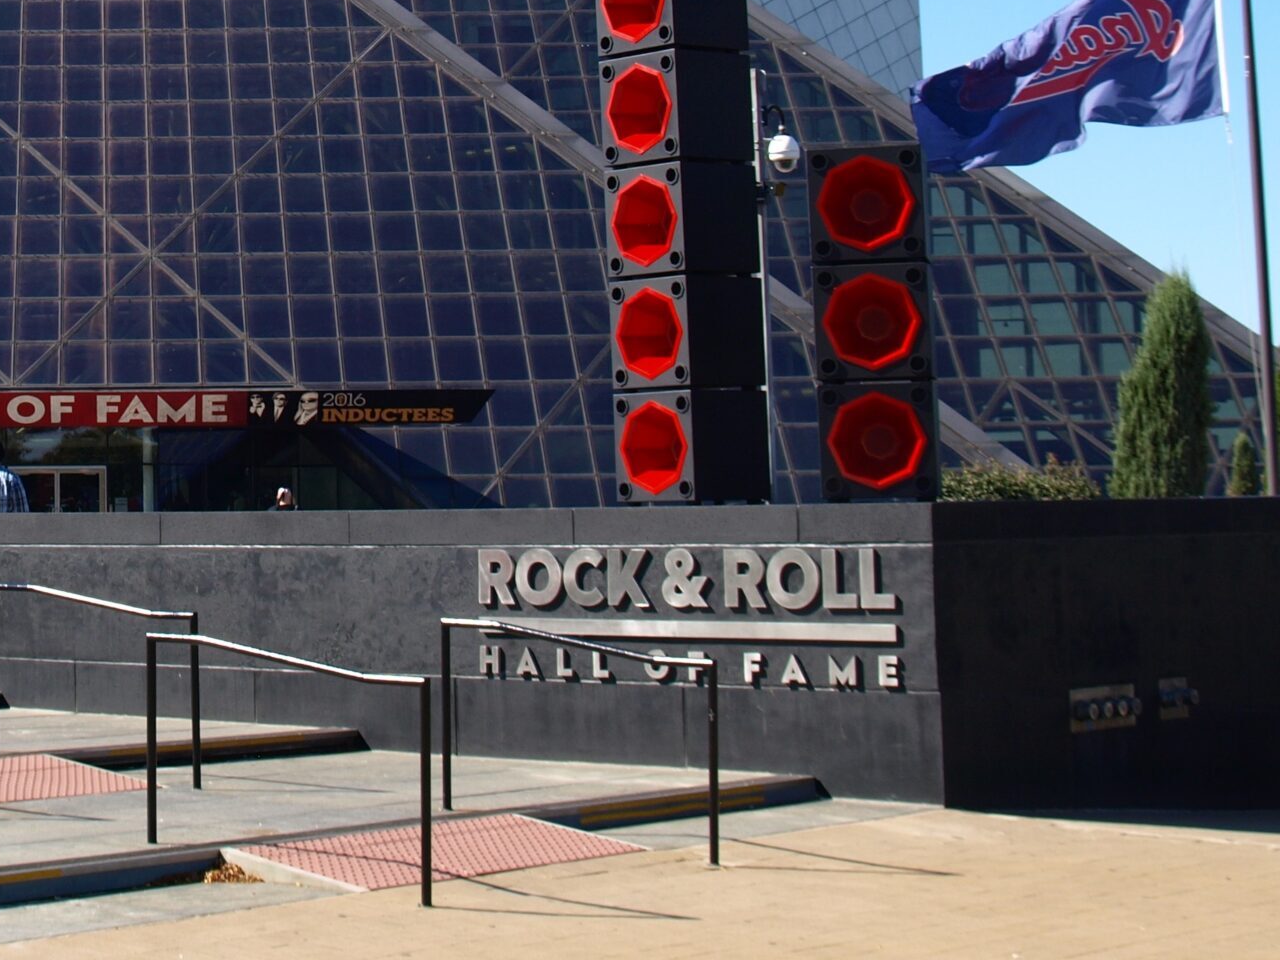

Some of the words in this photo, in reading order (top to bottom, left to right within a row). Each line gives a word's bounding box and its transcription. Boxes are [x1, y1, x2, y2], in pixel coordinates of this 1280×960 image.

[7, 395, 75, 424] OF
[96, 394, 228, 423] FAME
[322, 392, 366, 407] 2016
[322, 408, 455, 422] INDUCTEES
[478, 548, 651, 608] ROCK
[661, 548, 710, 608] &
[723, 548, 896, 610] ROLL
[479, 644, 610, 678] HALL
[643, 648, 705, 681] OF
[743, 651, 899, 688] FAME
